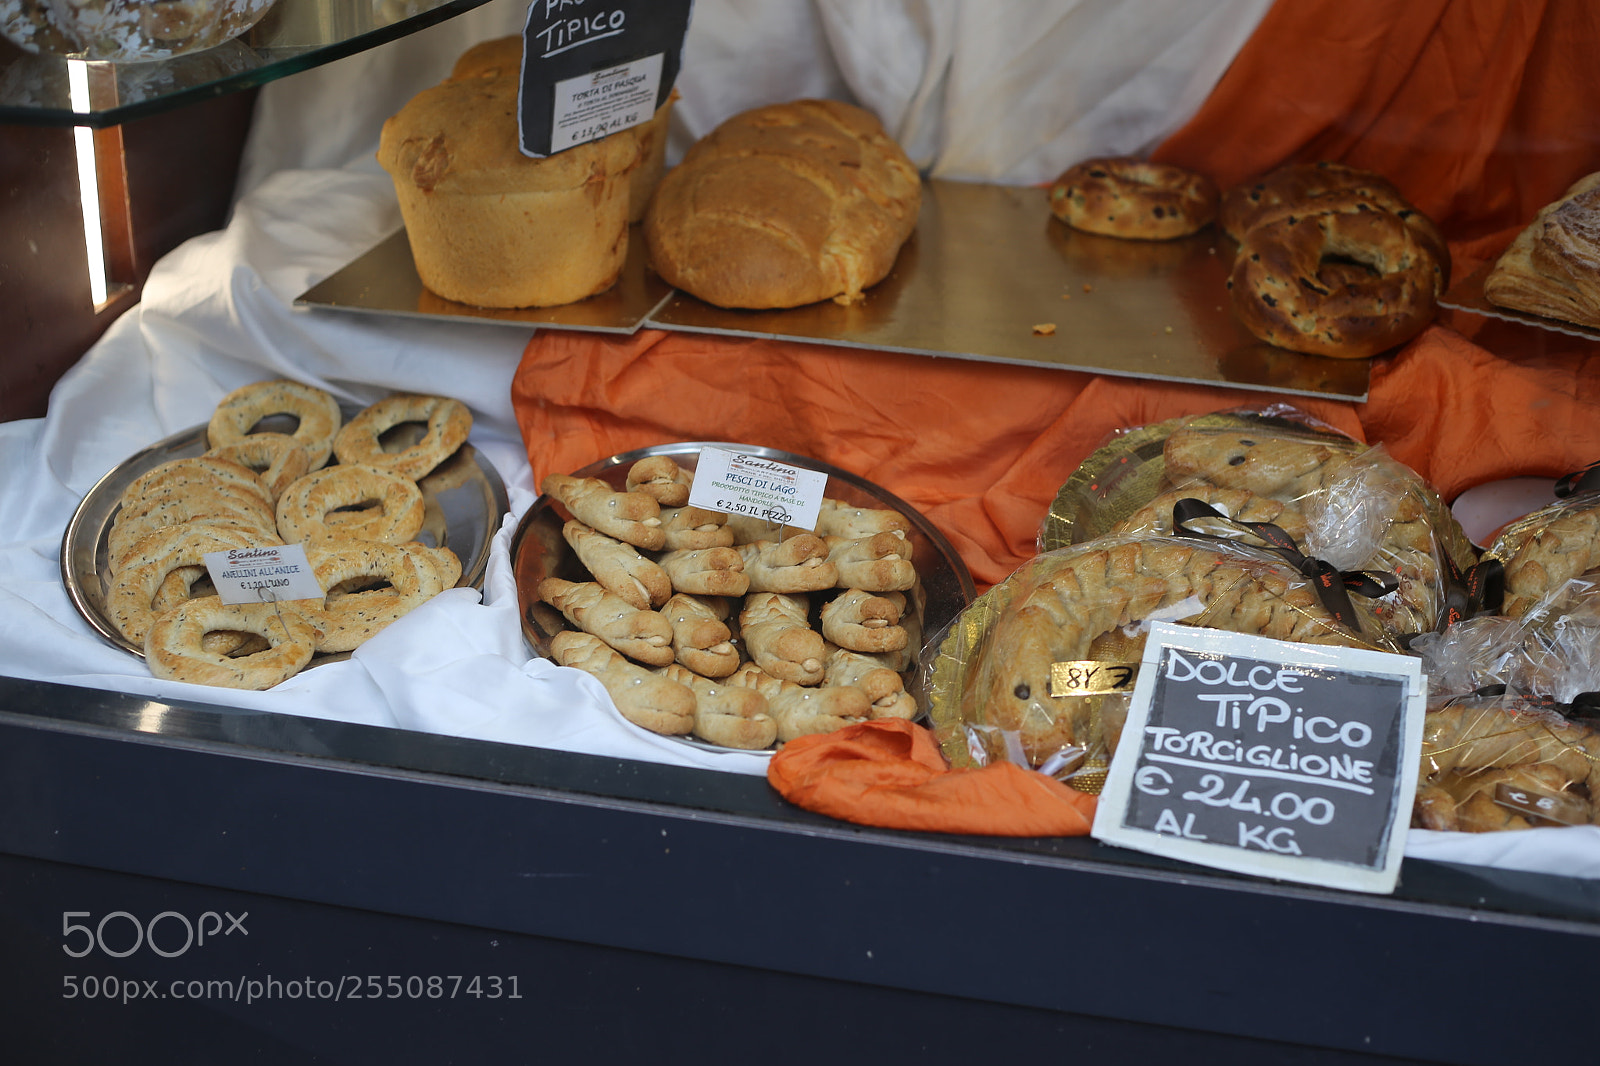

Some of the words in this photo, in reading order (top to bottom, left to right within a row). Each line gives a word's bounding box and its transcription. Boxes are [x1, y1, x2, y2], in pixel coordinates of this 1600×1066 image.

[571, 88, 600, 102] TORTA
[602, 83, 613, 94] DI
[614, 73, 647, 90] PASQUA
[732, 455, 797, 476] Santino
[726, 473, 753, 486] PESCI
[755, 479, 767, 489] DI
[770, 482, 796, 495] LAGO
[752, 490, 774, 500] TIPICO
[716, 499, 724, 508] €
[725, 501, 747, 513] 2,50
[748, 507, 759, 516] IL
[761, 509, 792, 523] PEZZO
[228, 549, 280, 560] Santino
[222, 568, 258, 579] ANELLINI
[259, 565, 300, 576] ALL'ANICE
[240, 581, 247, 590] €
[1165, 649, 1305, 694] DOLCE
[1135, 765, 1173, 796] €
[1182, 774, 1335, 826] 24.00
[1154, 809, 1207, 840] AL
[1238, 822, 1302, 856] KG
